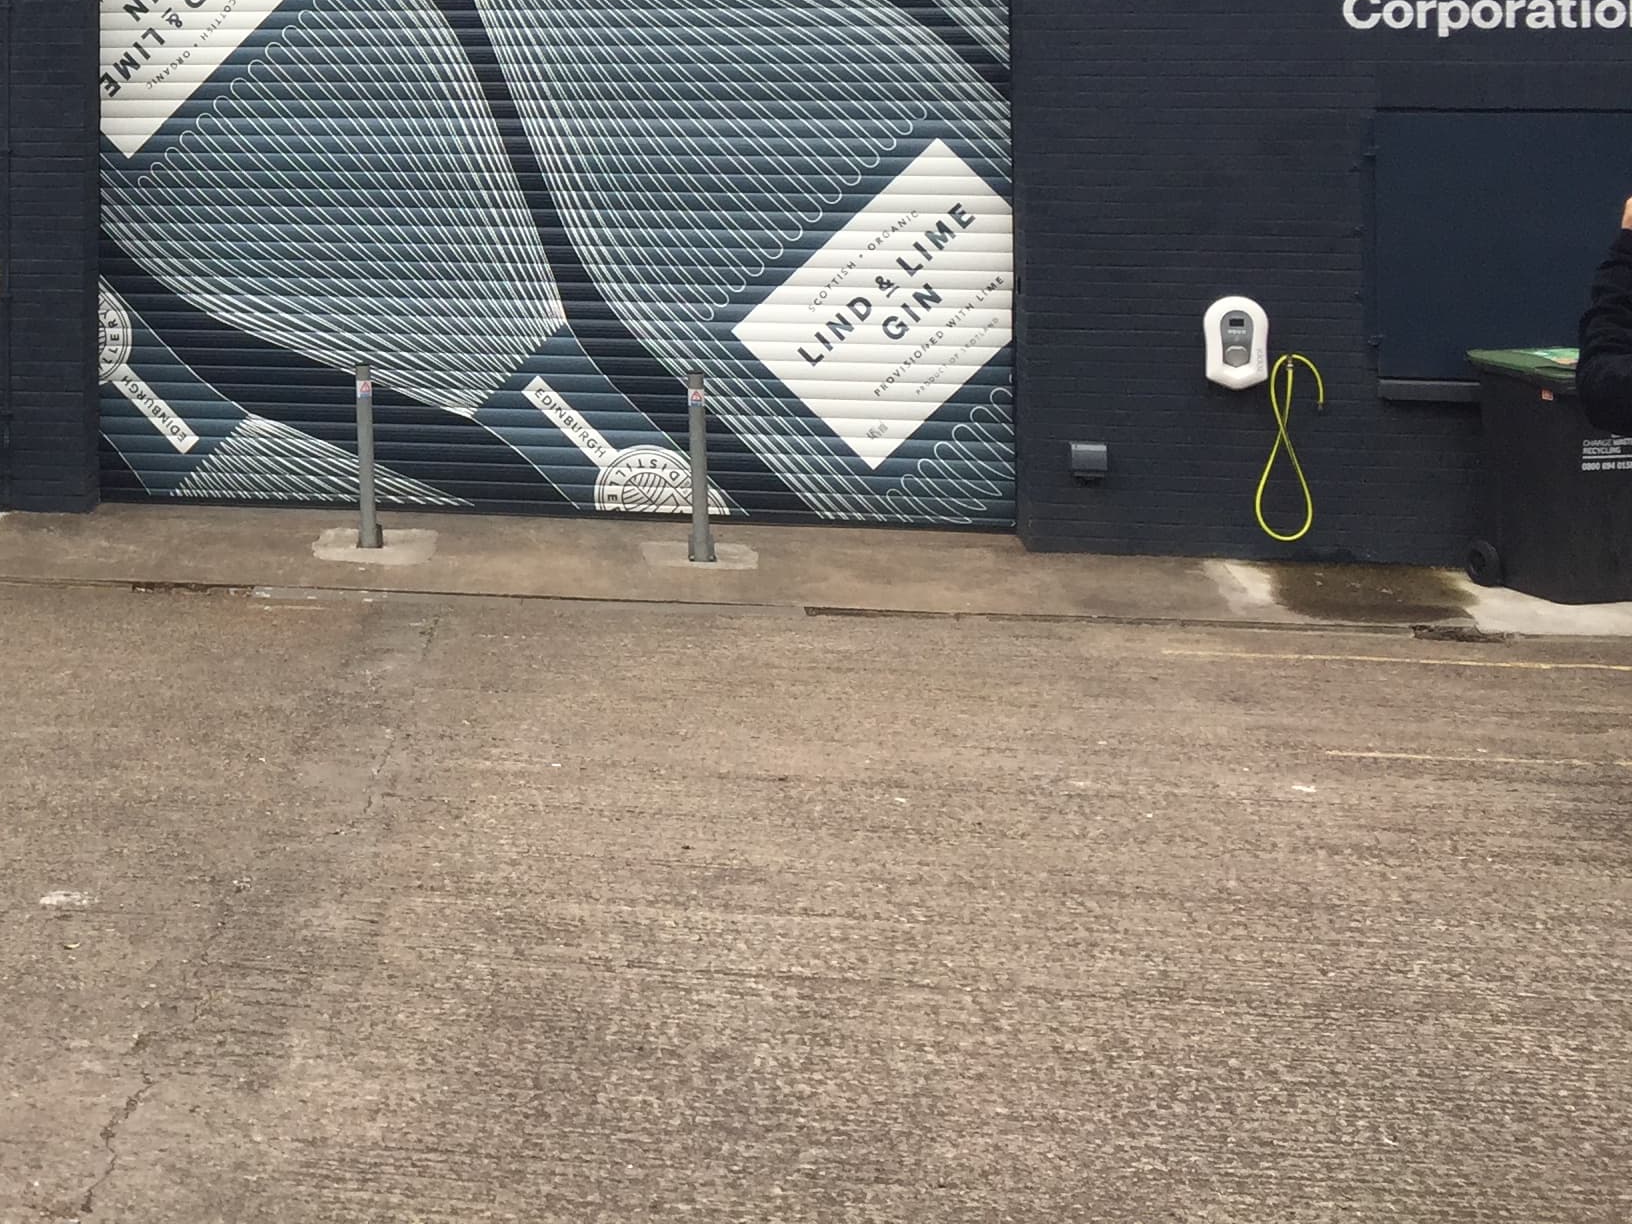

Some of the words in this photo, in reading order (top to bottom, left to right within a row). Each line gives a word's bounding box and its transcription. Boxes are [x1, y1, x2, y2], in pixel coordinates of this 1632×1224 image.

[161, 7, 183, 29] &
[99, 26, 166, 98] LIME
[796, 295, 873, 367] LIND
[875, 275, 901, 299] &
[895, 202, 976, 278] LIME
[807, 260, 857, 313] SCOTTISH
[867, 210, 919, 252] ORGANIC
[881, 282, 943, 342] GIN
[945, 302, 976, 330] WITH
[976, 274, 1005, 303] LIME
[120, 374, 188, 443] EDINBURGH
[534, 387, 607, 459] EDINBURGH
